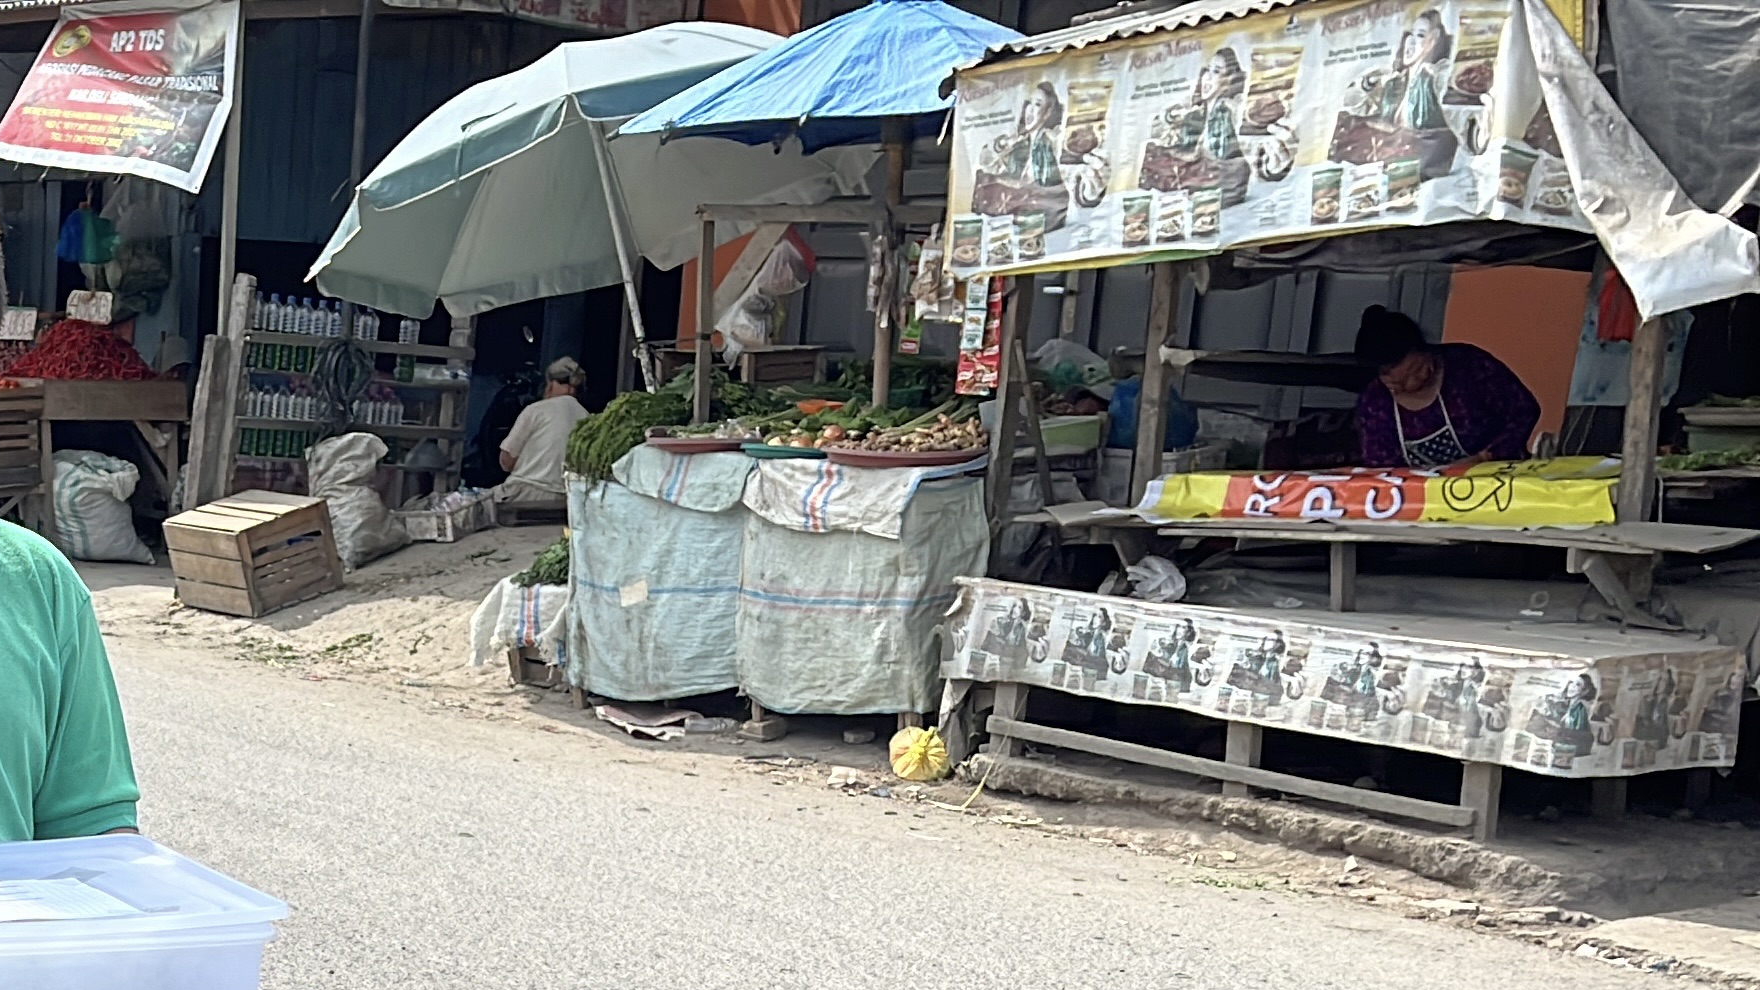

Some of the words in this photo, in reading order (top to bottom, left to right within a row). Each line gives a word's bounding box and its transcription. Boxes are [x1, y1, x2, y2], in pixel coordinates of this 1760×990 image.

[109, 30, 135, 53] AP2
[138, 28, 166, 52] TDS
[160, 75, 219, 92] TRADISIONAL
